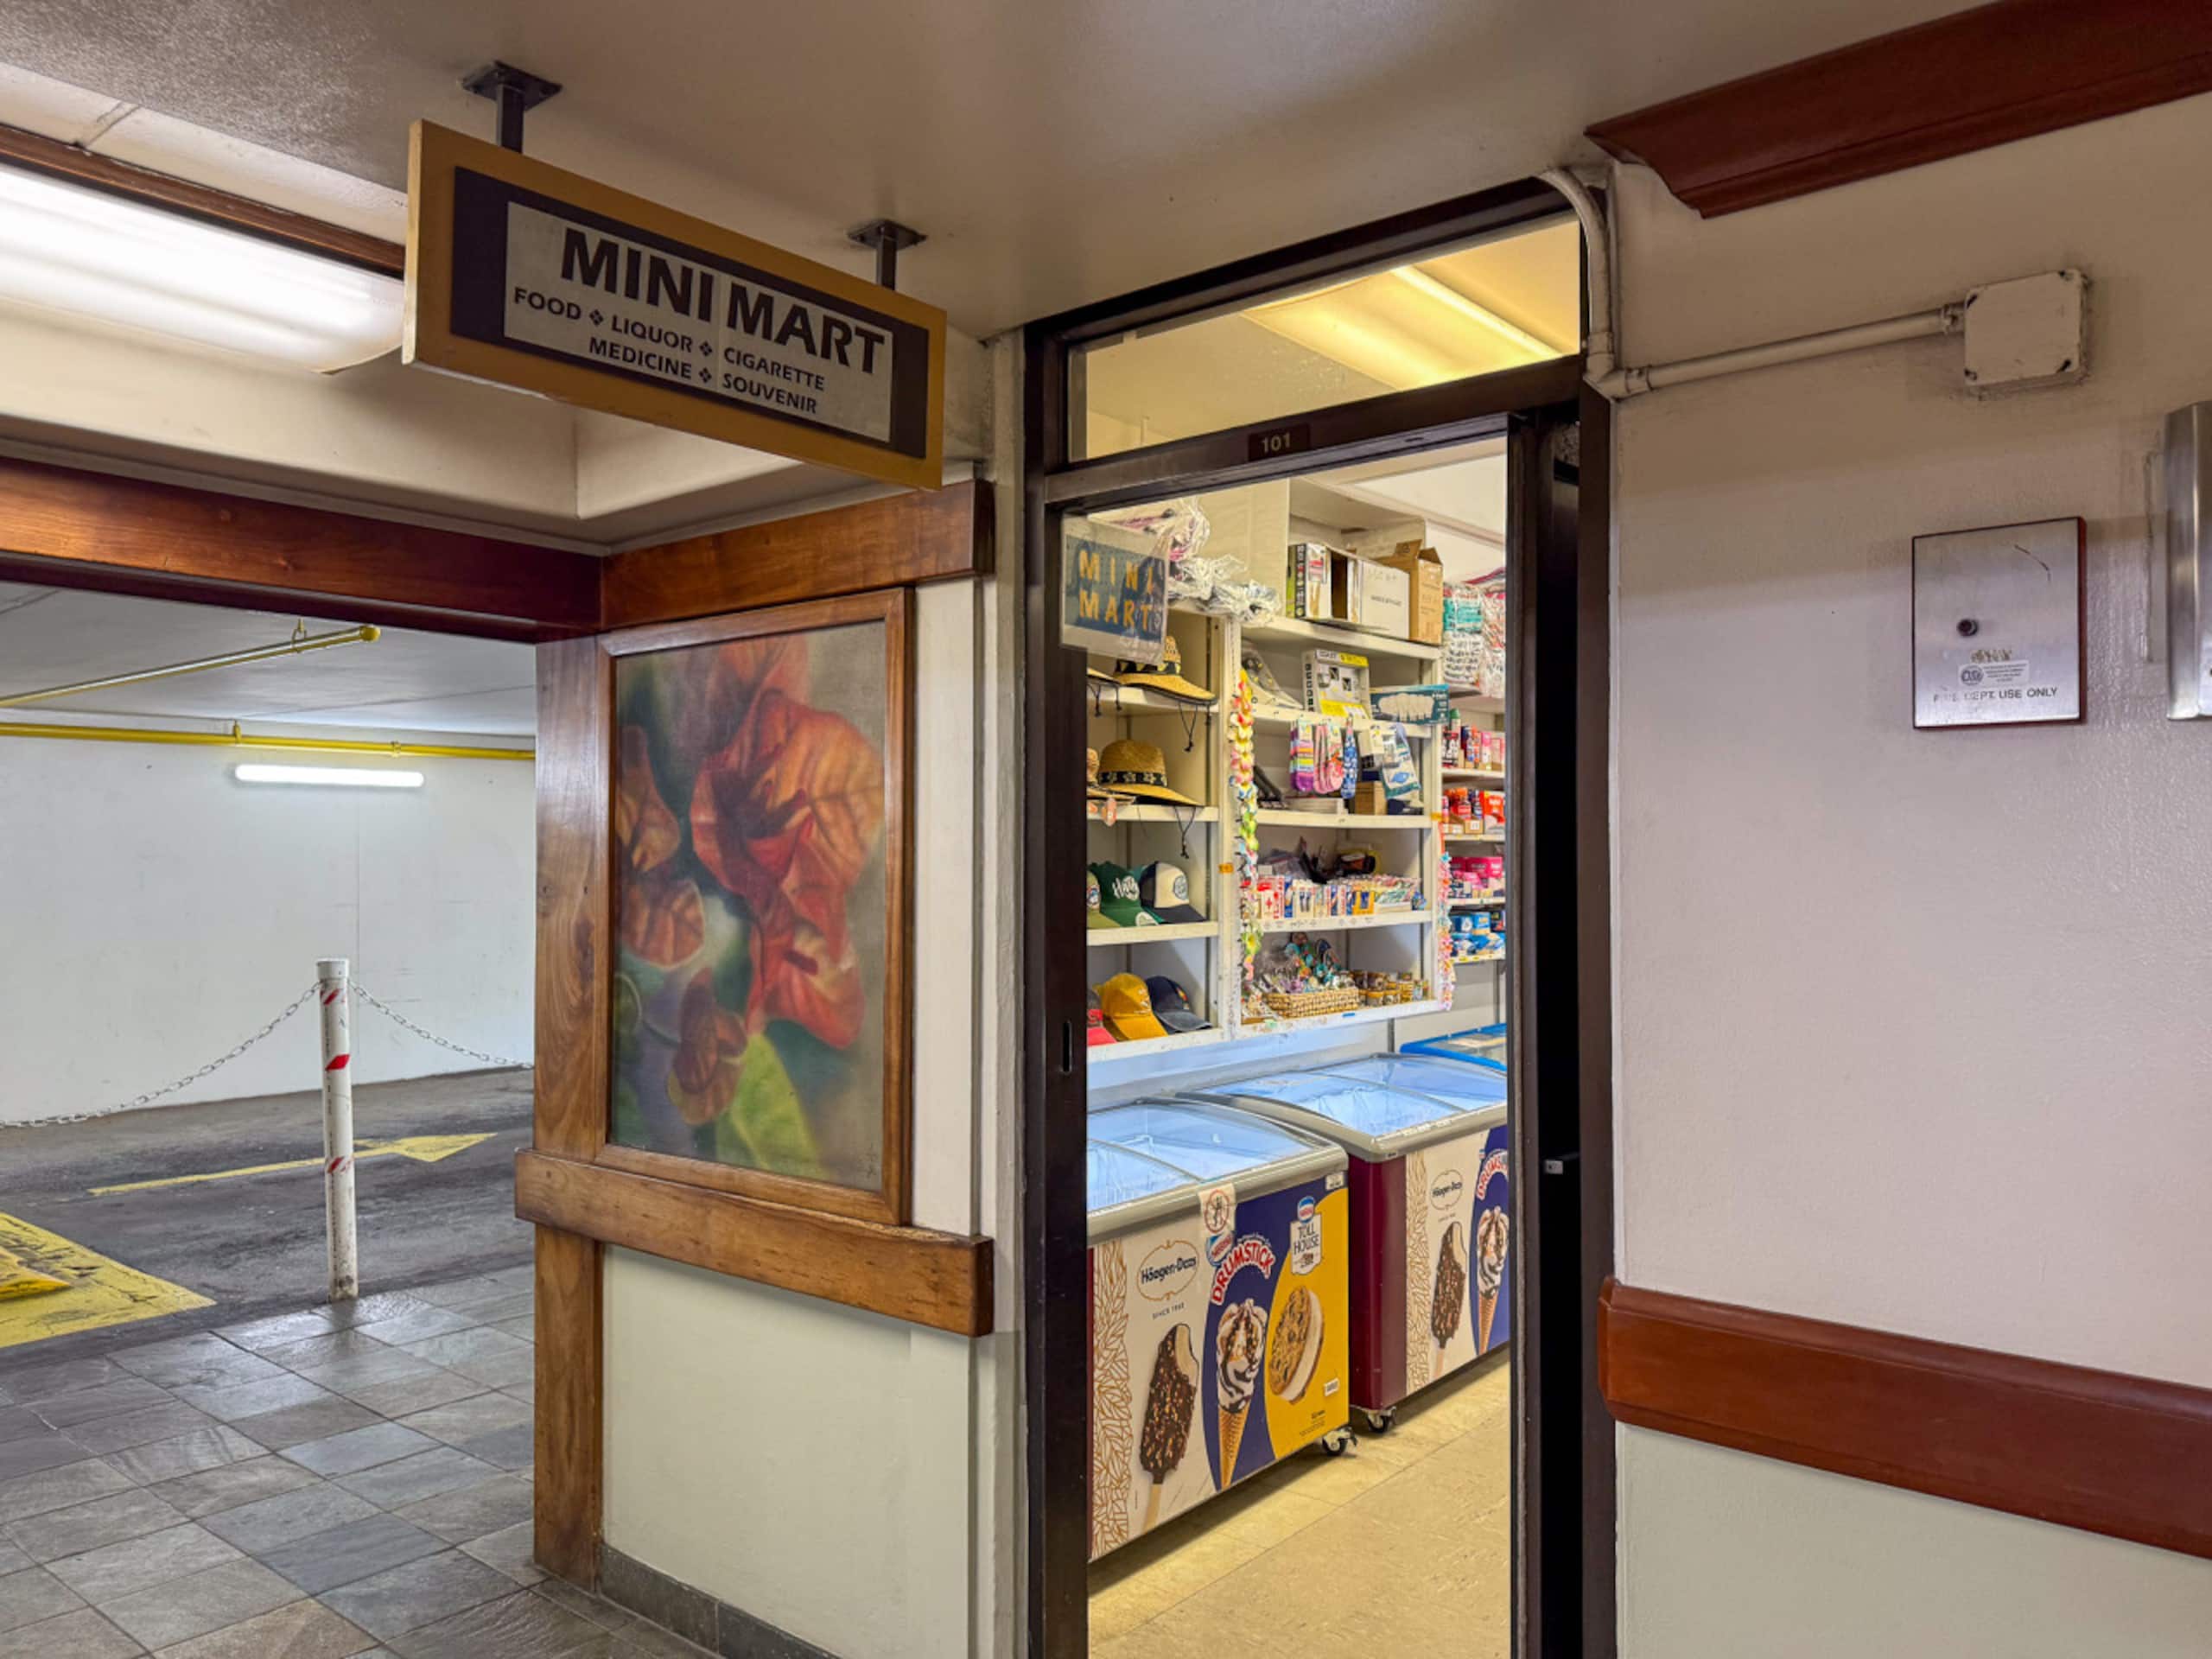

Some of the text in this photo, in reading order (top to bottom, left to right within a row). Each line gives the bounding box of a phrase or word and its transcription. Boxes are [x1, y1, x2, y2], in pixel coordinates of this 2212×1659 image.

[561, 226, 885, 374] MINI MART
[514, 286, 825, 391] FOOD LIQUOR CIGARETTE
[588, 336, 817, 414] MEDICINE SOUVENIR
[1262, 432, 1291, 454] 101
[1079, 550, 1154, 594] MINI
[1079, 588, 1153, 630] MART
[1999, 689, 2023, 699] USE
[2026, 686, 2058, 697] ONLY
[1293, 1234, 1319, 1255] HOUSE
[1211, 1240, 1276, 1306] DRUMSTICK
